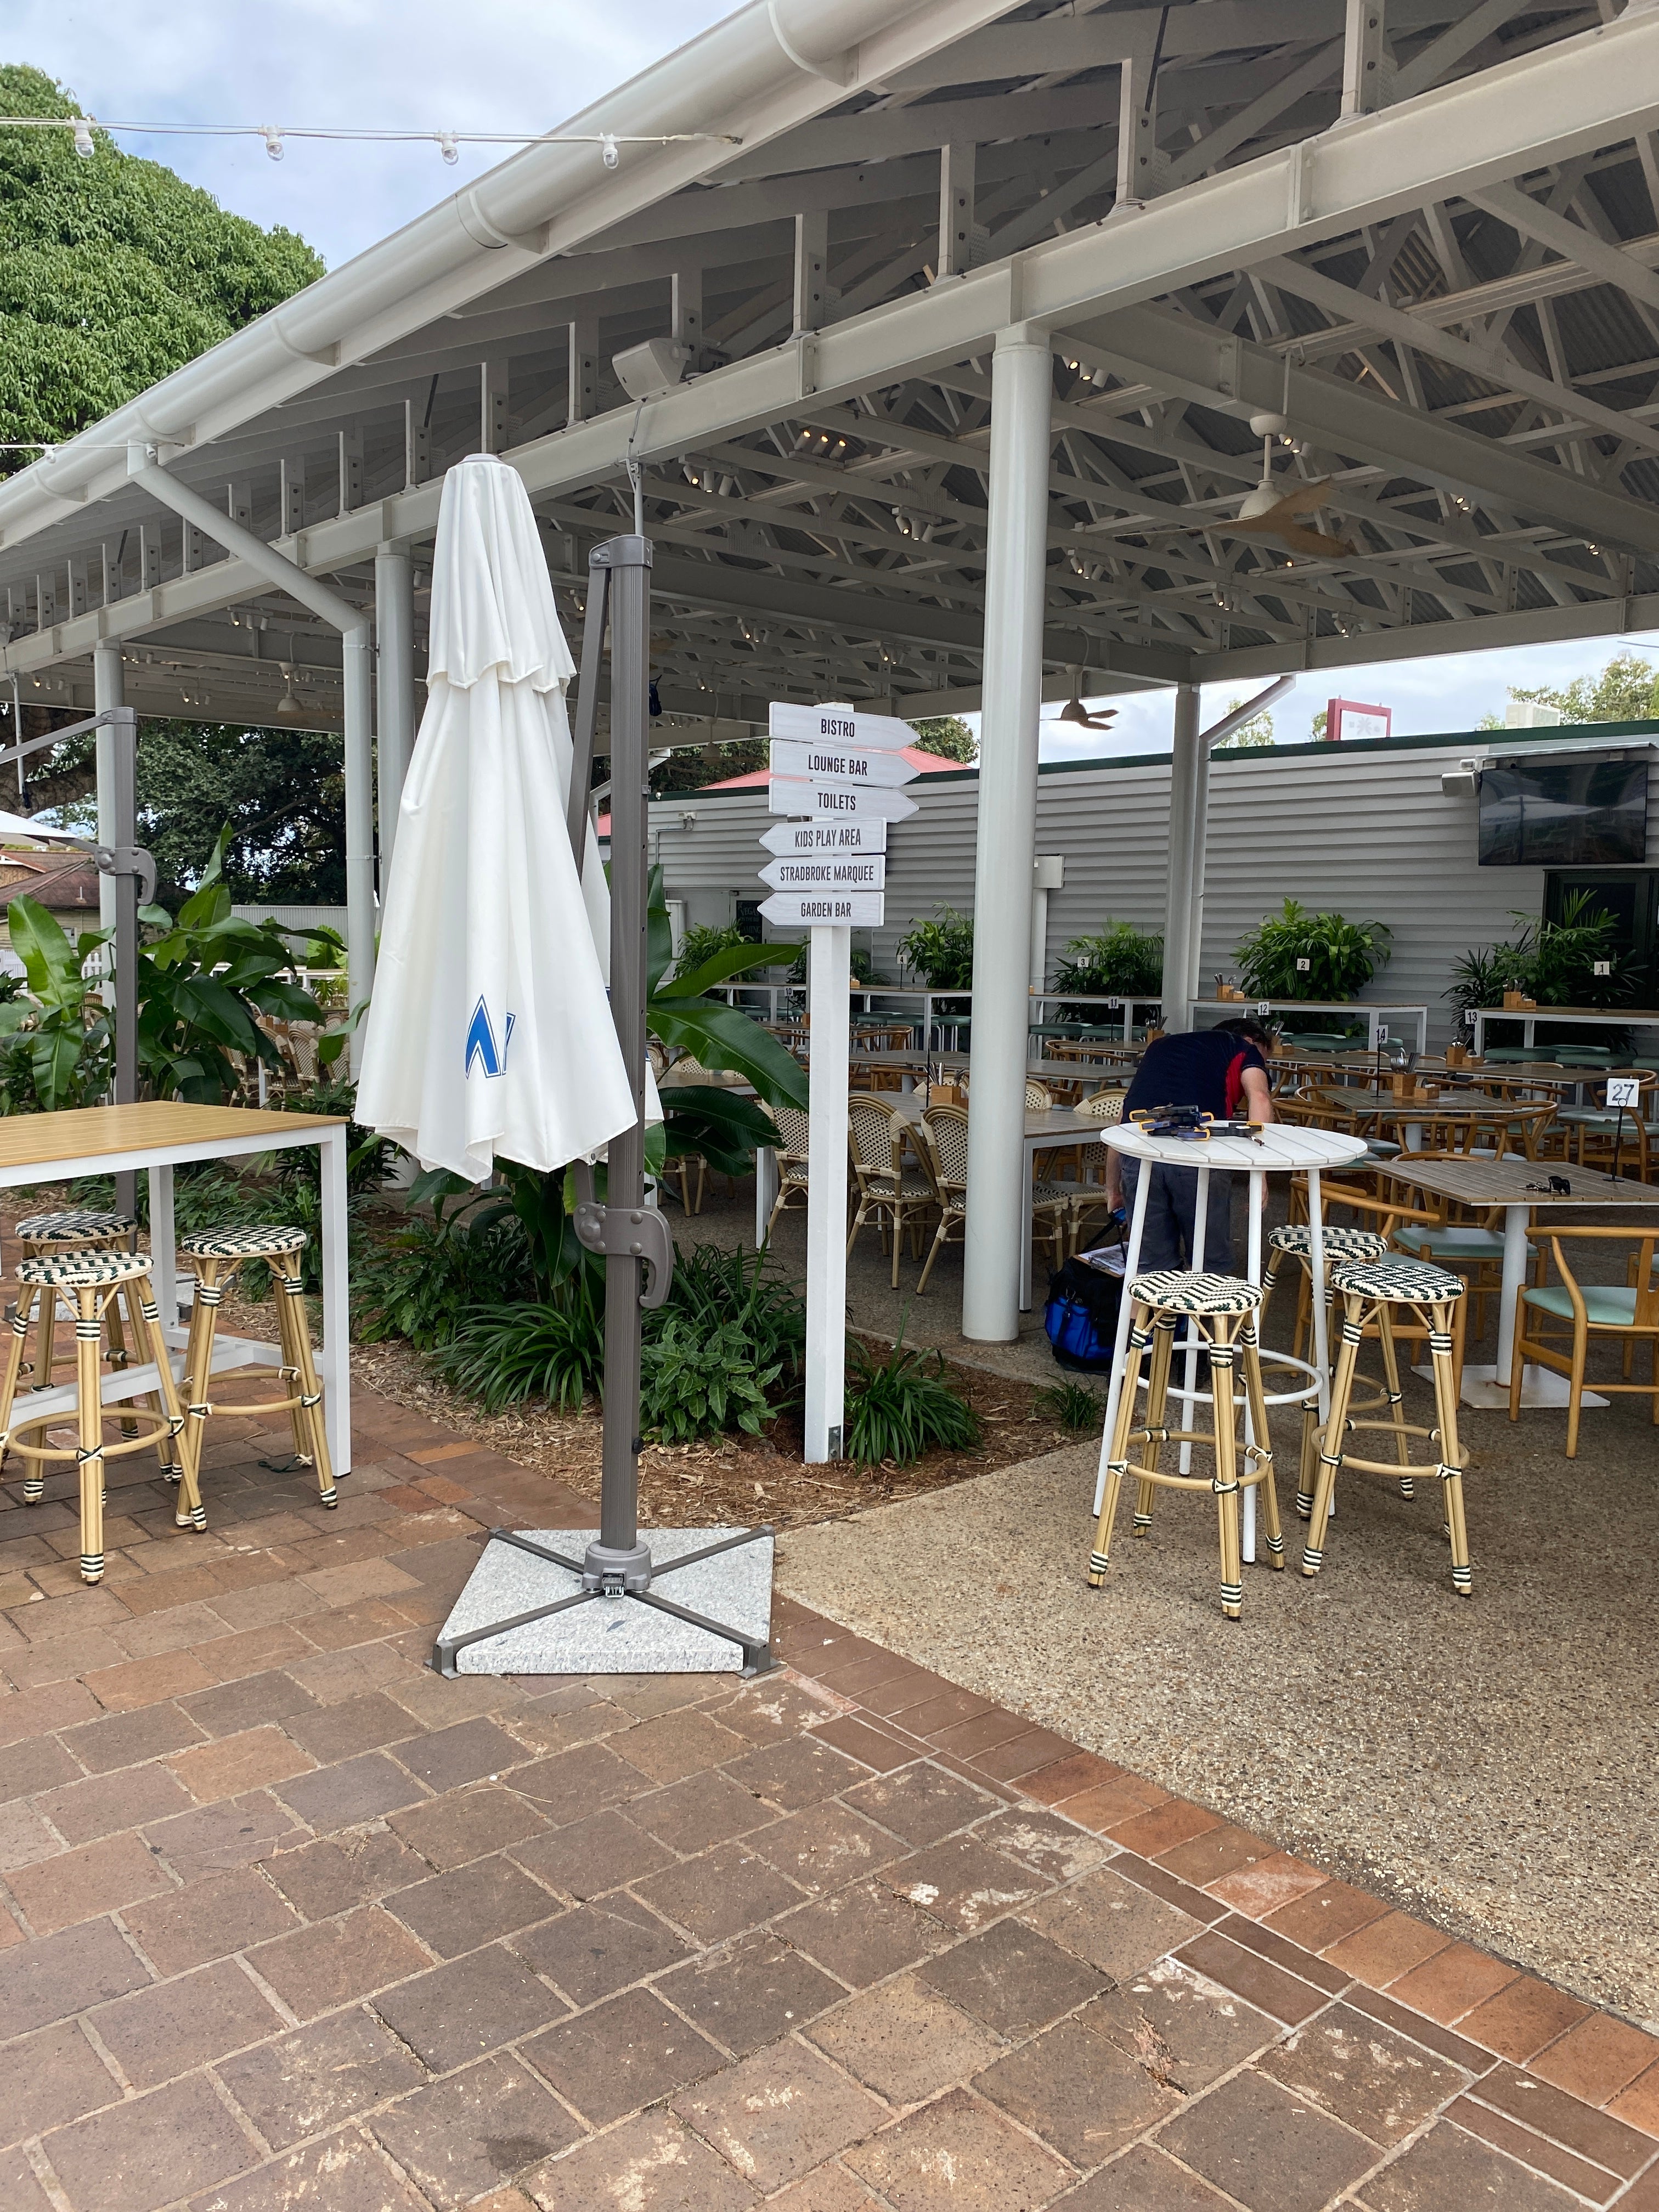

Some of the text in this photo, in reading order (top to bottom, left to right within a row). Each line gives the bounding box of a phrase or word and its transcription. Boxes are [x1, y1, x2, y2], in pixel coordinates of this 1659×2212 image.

[821, 719, 855, 737] BISTRO
[808, 754, 868, 776] LOUNGE BAR
[817, 793, 856, 810] TOILETS
[795, 828, 861, 848] KIDS PLAY AREA
[780, 865, 874, 883] STRADBROKE MARQUEE
[801, 902, 851, 918] GARDEN BAR
[1301, 961, 1306, 969] 2
[1600, 963, 1604, 972] 1
[1110, 998, 1117, 1007] 11
[1260, 1004, 1268, 1013] 12
[1468, 1012, 1477, 1022] 13
[1376, 1029, 1386, 1041] 14
[1612, 1084, 1634, 1103] 27
